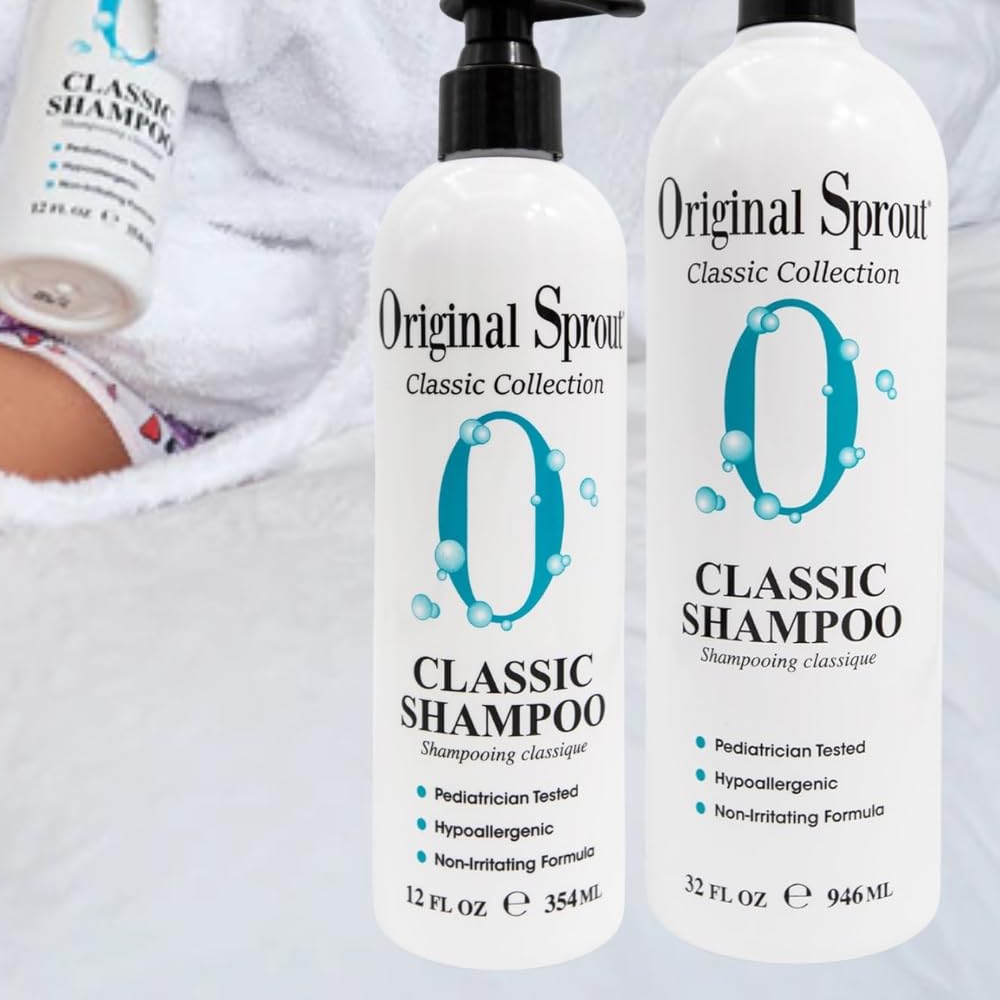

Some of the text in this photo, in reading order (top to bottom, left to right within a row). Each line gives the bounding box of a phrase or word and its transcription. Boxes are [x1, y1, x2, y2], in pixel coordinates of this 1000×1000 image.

[62, 70, 174, 126] CLASSIC
[45, 95, 176, 157] SHAMPOO
[659, 170, 928, 251] Original Sprout
[687, 260, 901, 285] Classic Collection
[379, 284, 624, 363] Original Sprout
[406, 371, 605, 396] Classic Collection
[695, 561, 888, 601] CLASSIC
[682, 601, 903, 644] SHAMPOO
[413, 654, 594, 695] CLASSIC
[700, 647, 877, 673] Shampooing classique
[401, 693, 607, 738] SHAMPOO
[420, 740, 589, 766] Shampooing classique
[715, 738, 866, 758] Pediatrician Tested
[434, 784, 579, 806] Pediatrician Tested
[715, 770, 839, 795] Hypoallergenic
[434, 819, 555, 842] Hypoallergenic
[714, 803, 885, 828] Non-Irritating Formula
[434, 846, 596, 874] Non-Irritating Formula
[406, 885, 425, 907] 12
[429, 894, 453, 914] FL
[457, 899, 488, 917] OZ
[684, 873, 705, 897] 32
[709, 883, 733, 904] FL
[737, 889, 768, 909] OZ
